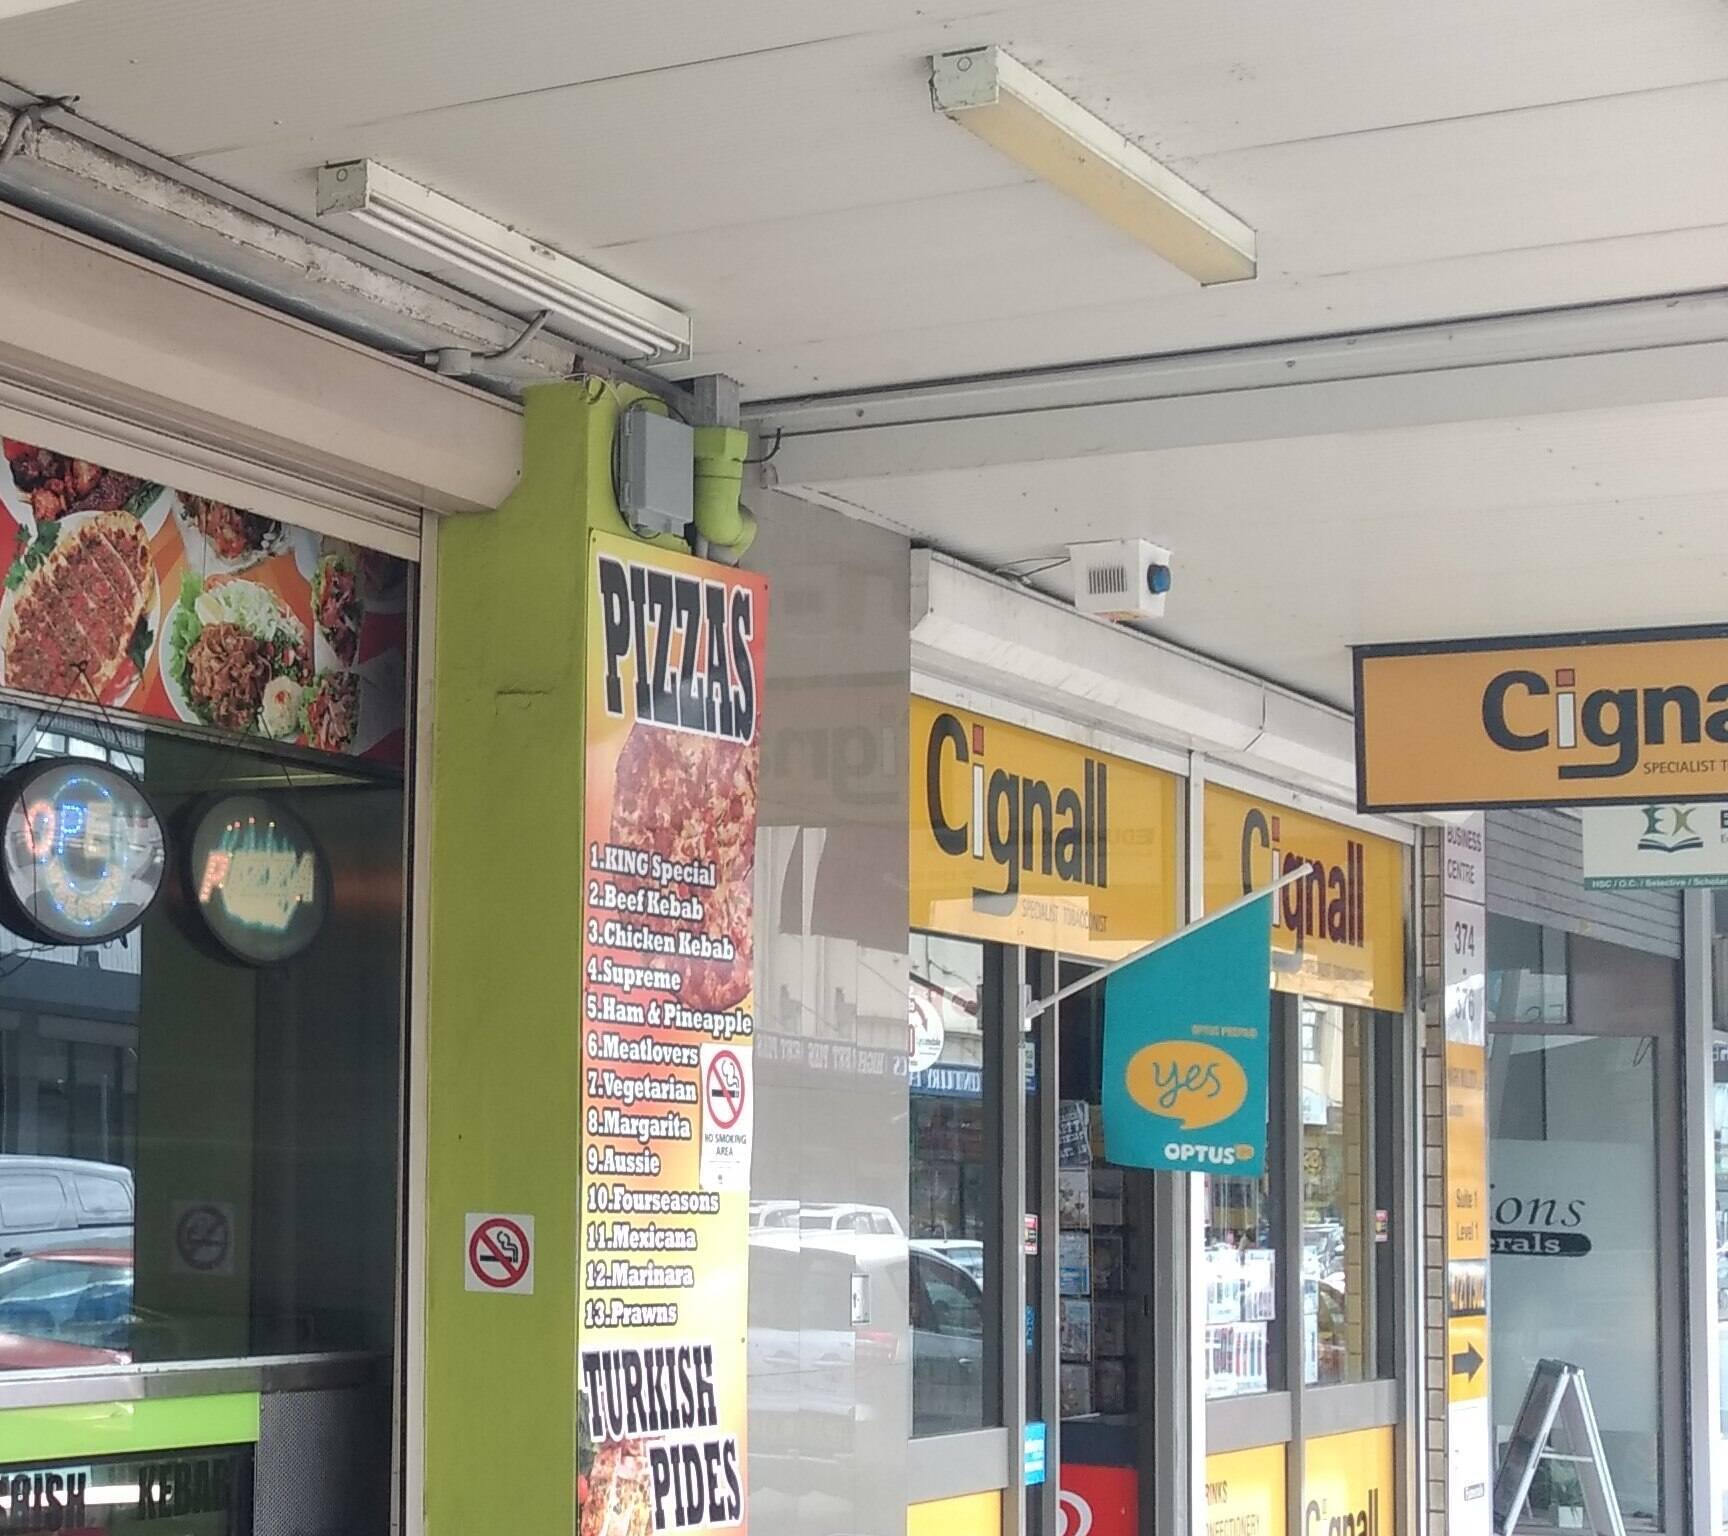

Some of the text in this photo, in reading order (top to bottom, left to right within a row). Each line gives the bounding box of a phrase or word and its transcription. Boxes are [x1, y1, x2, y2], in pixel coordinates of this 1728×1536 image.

[599, 557, 755, 740] PIZZAS
[1643, 760, 1715, 774] SPECIALIST
[927, 713, 1108, 917] Cignall
[1447, 826, 1482, 852] BUSINESS
[590, 844, 715, 887] 1.KING Special
[1447, 858, 1475, 884] CENTRE
[589, 882, 703, 920] 2.Beef Kebab
[588, 920, 734, 960] 3.Chicken Kebab
[1454, 922, 1475, 957] 374
[587, 957, 681, 993] 4.Supreme
[587, 995, 752, 1037] 5.Ham & Pineapple
[588, 1033, 698, 1065] 6.Meatlovers
[588, 1071, 696, 1103] 7.Vegetarian
[1151, 1061, 1221, 1109] yes
[588, 1110, 690, 1142] 8.Margarita
[705, 1134, 746, 1144] NO SMOKING
[588, 1146, 660, 1174] 9.Aussie
[716, 1146, 733, 1156] AREA
[1164, 1143, 1235, 1165] OPTUS
[588, 1184, 719, 1212] 10.Fourseasons
[1456, 1189, 1473, 1208] Suite
[587, 1222, 696, 1249] 11.Mexicana
[1456, 1223, 1474, 1240] Level
[587, 1261, 693, 1288] 12.Marinara
[585, 1299, 677, 1327] 13.Prawns
[583, 1345, 716, 1437] TURKISH
[650, 1440, 741, 1529] PIDES
